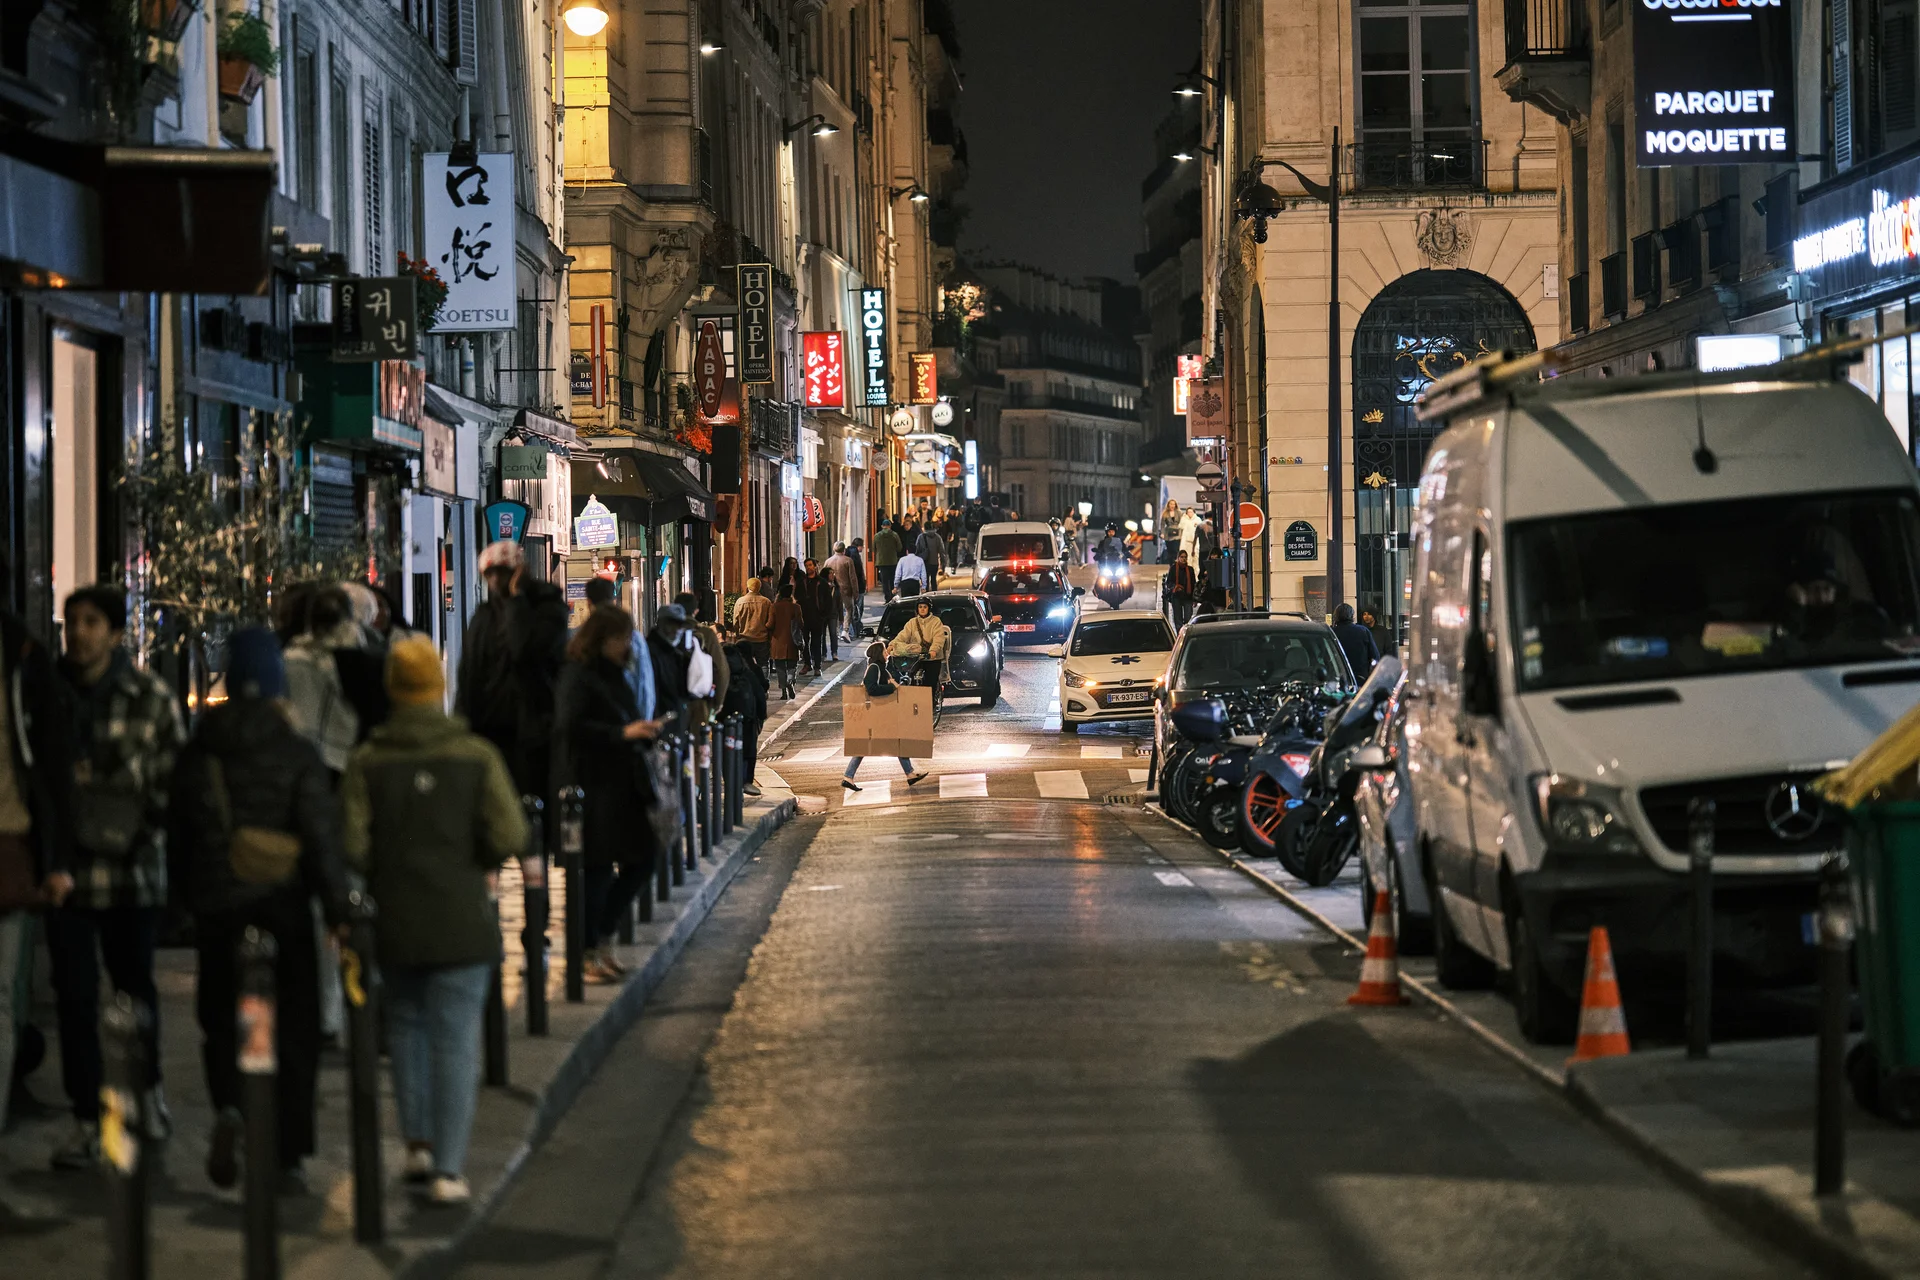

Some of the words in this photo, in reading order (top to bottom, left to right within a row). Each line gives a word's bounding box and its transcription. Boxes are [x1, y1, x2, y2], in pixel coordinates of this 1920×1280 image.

[1655, 90, 1774, 115] PARQUET
[1645, 127, 1787, 153] MOQUETTE
[365, 288, 407, 353] 귀빈
[434, 309, 509, 323] KOETSU
[743, 272, 765, 360] HOTEL
[863, 290, 885, 387] HOTEL
[704, 335, 715, 404] TABAC
[807, 351, 827, 404] ひぐま
[826, 335, 841, 396] ラーメン
[500, 526, 511, 534] 39
